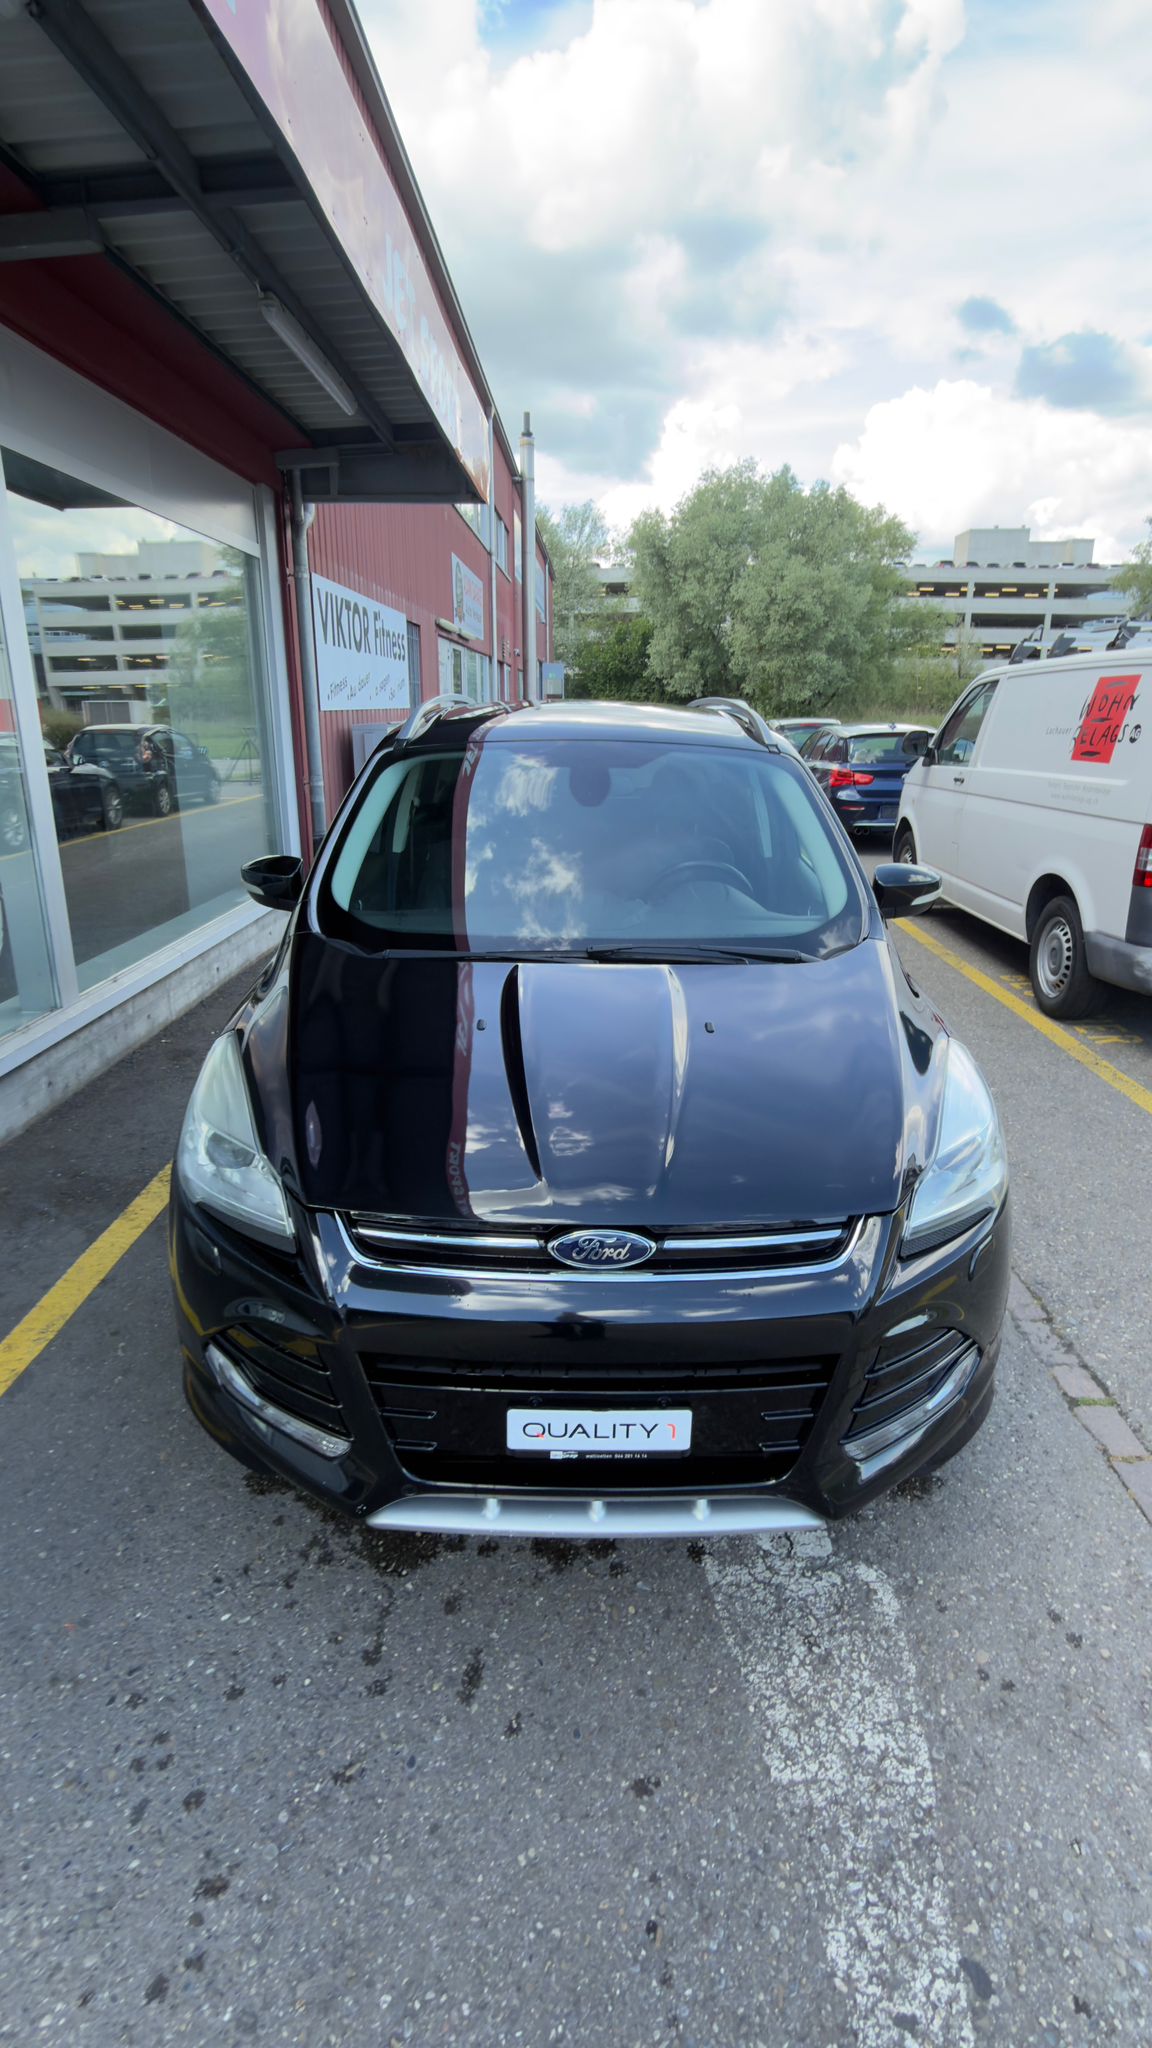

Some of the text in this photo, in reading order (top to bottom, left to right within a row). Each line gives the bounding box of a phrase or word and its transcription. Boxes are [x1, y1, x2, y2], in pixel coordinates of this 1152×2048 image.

[316, 587, 406, 662] VIKTOR Fitness
[1079, 694, 1140, 720] WOHN
[572, 1236, 631, 1260] Ford
